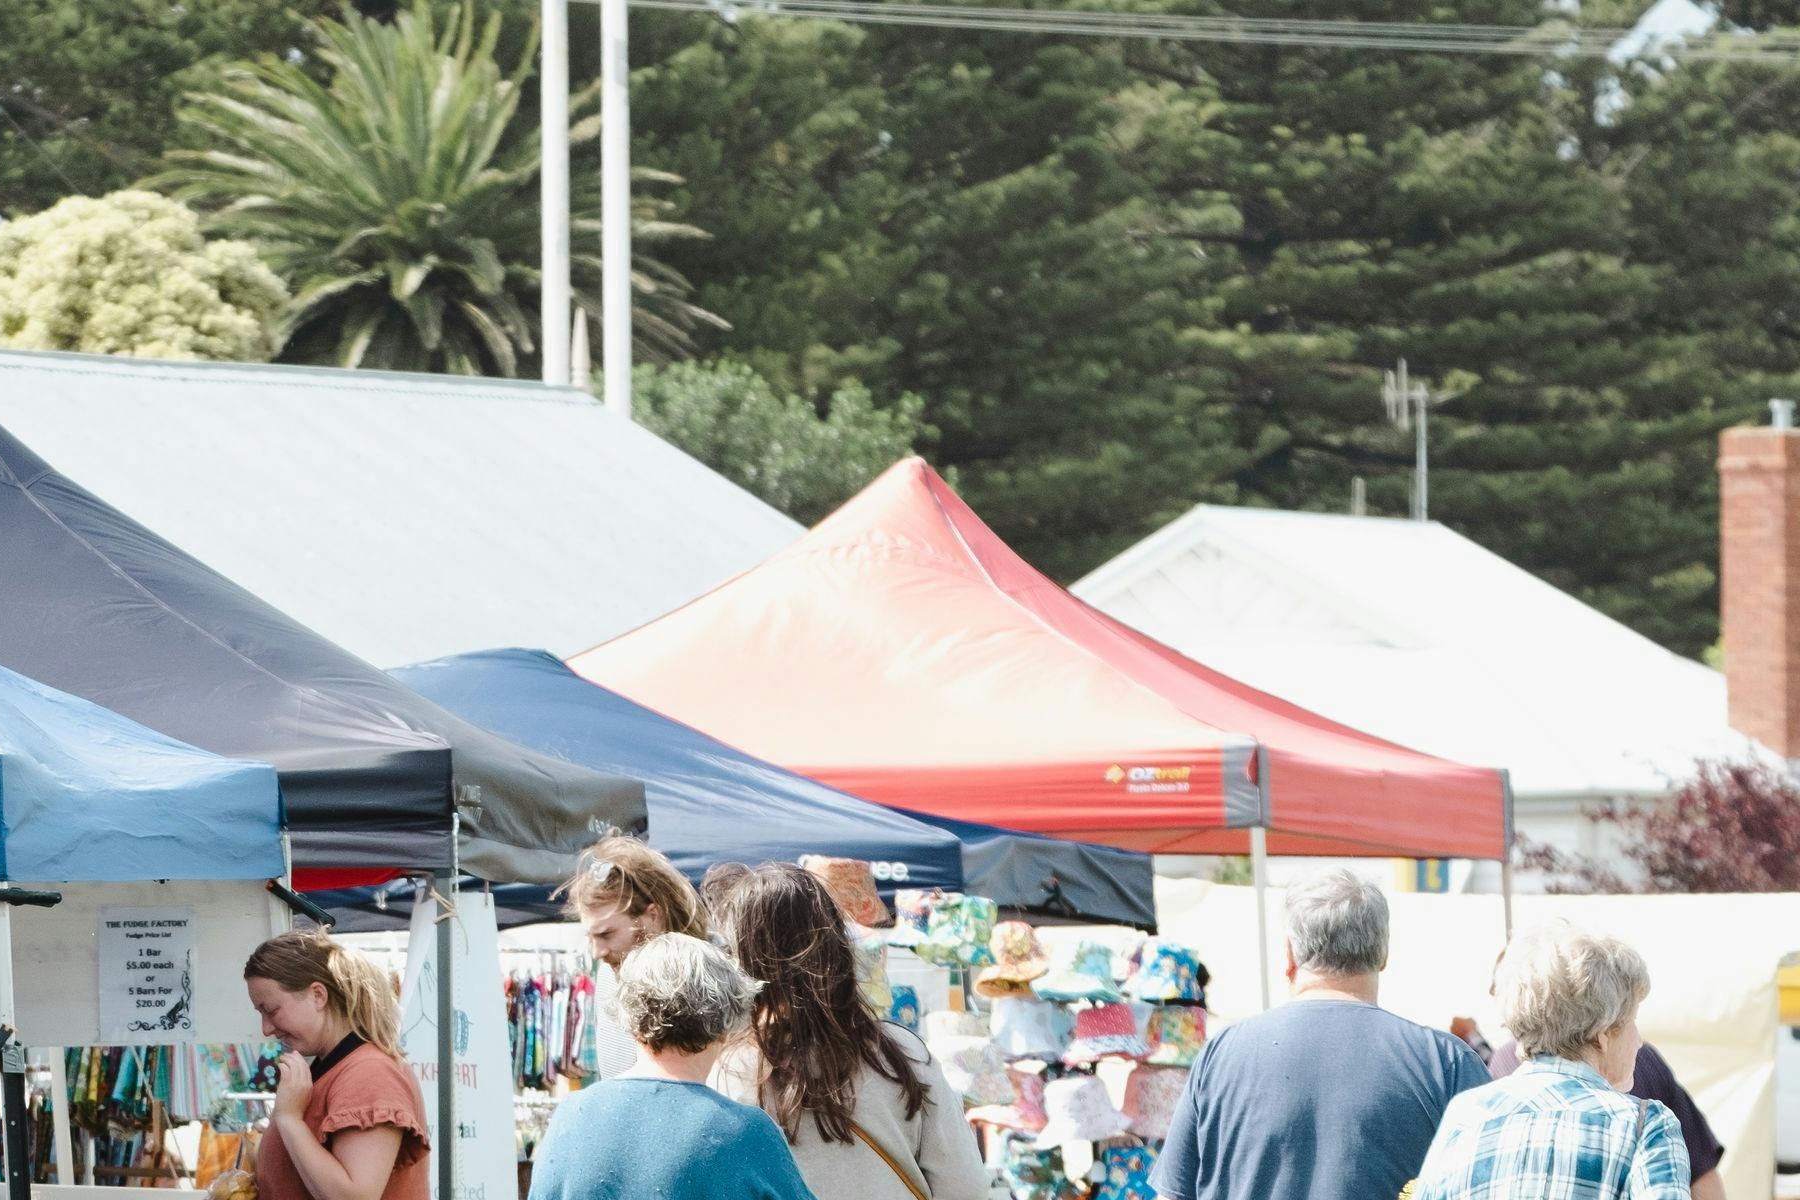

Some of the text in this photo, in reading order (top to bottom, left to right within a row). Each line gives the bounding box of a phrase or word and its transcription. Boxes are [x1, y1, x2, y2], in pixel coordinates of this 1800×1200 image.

[123, 920, 149, 928] FUDGE
[151, 919, 189, 928] FACTORY
[146, 948, 161, 957] Bar
[126, 961, 174, 970] $5.00 each
[128, 986, 173, 995] 5 Bars For
[136, 999, 166, 1008] $20.00
